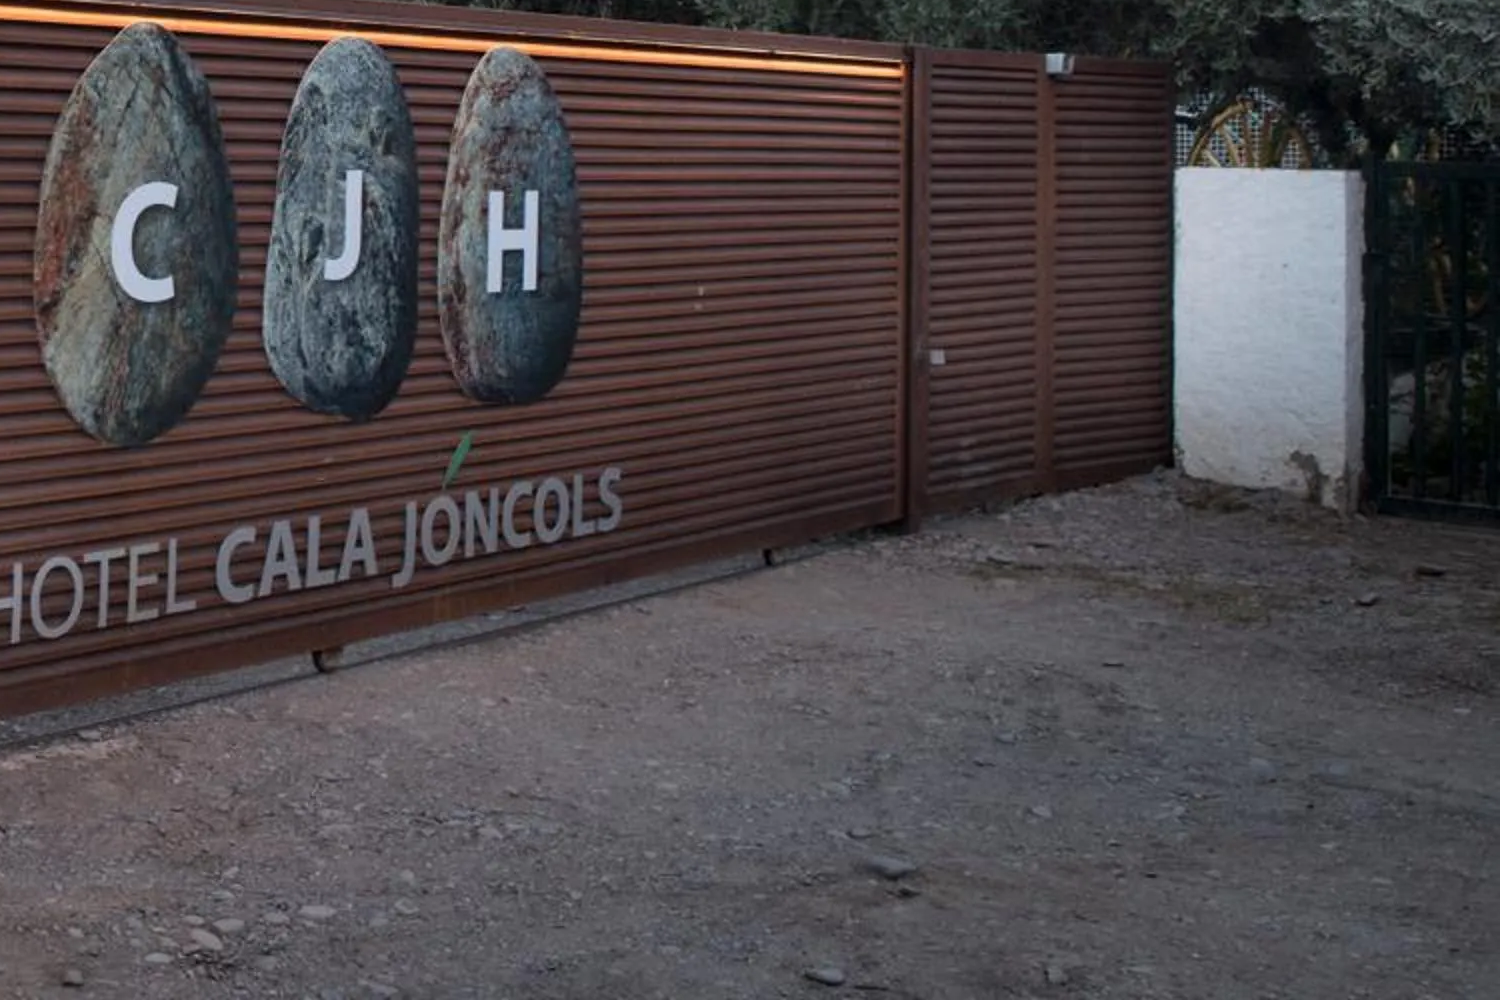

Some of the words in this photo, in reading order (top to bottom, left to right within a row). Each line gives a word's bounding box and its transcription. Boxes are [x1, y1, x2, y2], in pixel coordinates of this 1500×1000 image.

[111, 181, 178, 302] C
[324, 170, 362, 280] J
[486, 190, 539, 292] H
[215, 507, 377, 602] CALA
